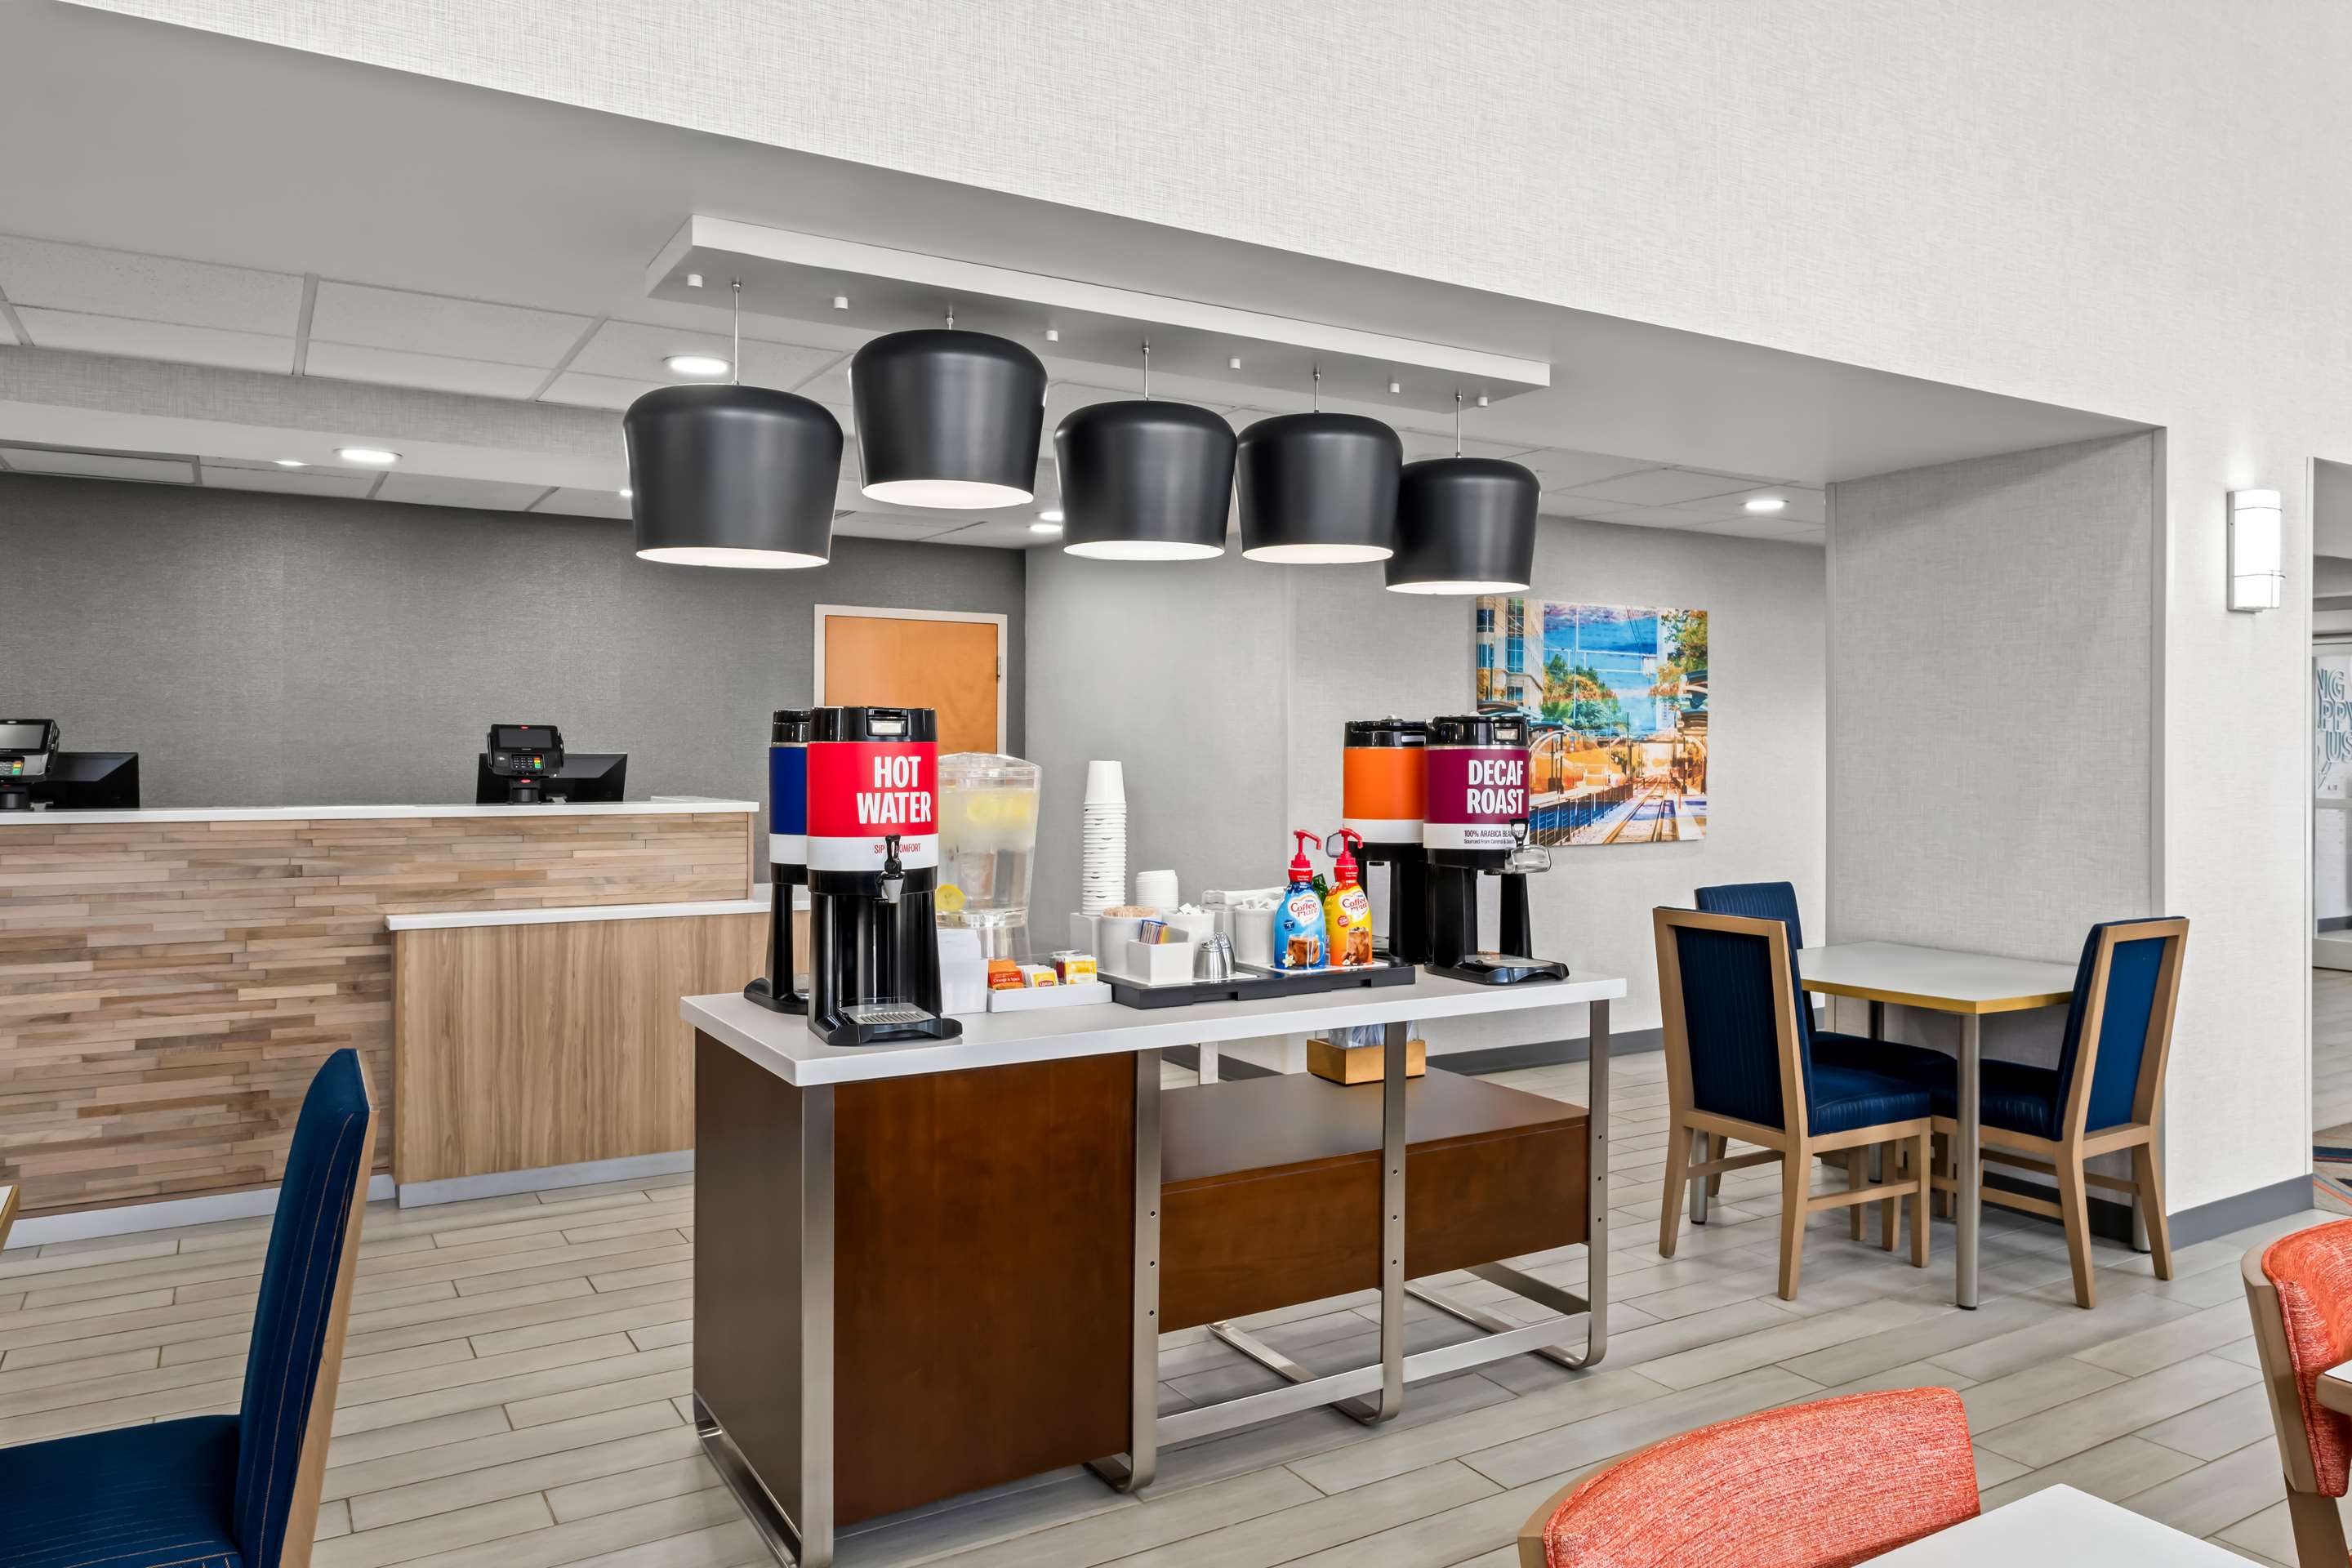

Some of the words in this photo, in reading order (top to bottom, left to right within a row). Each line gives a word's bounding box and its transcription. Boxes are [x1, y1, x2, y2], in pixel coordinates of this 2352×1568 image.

[2317, 668, 2345, 700] NG
[874, 755, 921, 788] HOT
[1468, 760, 1524, 786] DECAF
[856, 791, 932, 824] WATER
[1467, 788, 1524, 814] ROAST
[1464, 830, 1479, 838] 100%
[1480, 830, 1502, 838] ARABICA
[874, 844, 885, 854] SIP
[899, 843, 921, 853] OMFORT
[1290, 902, 1316, 912] Coffee
[1342, 897, 1367, 908] Coffee
